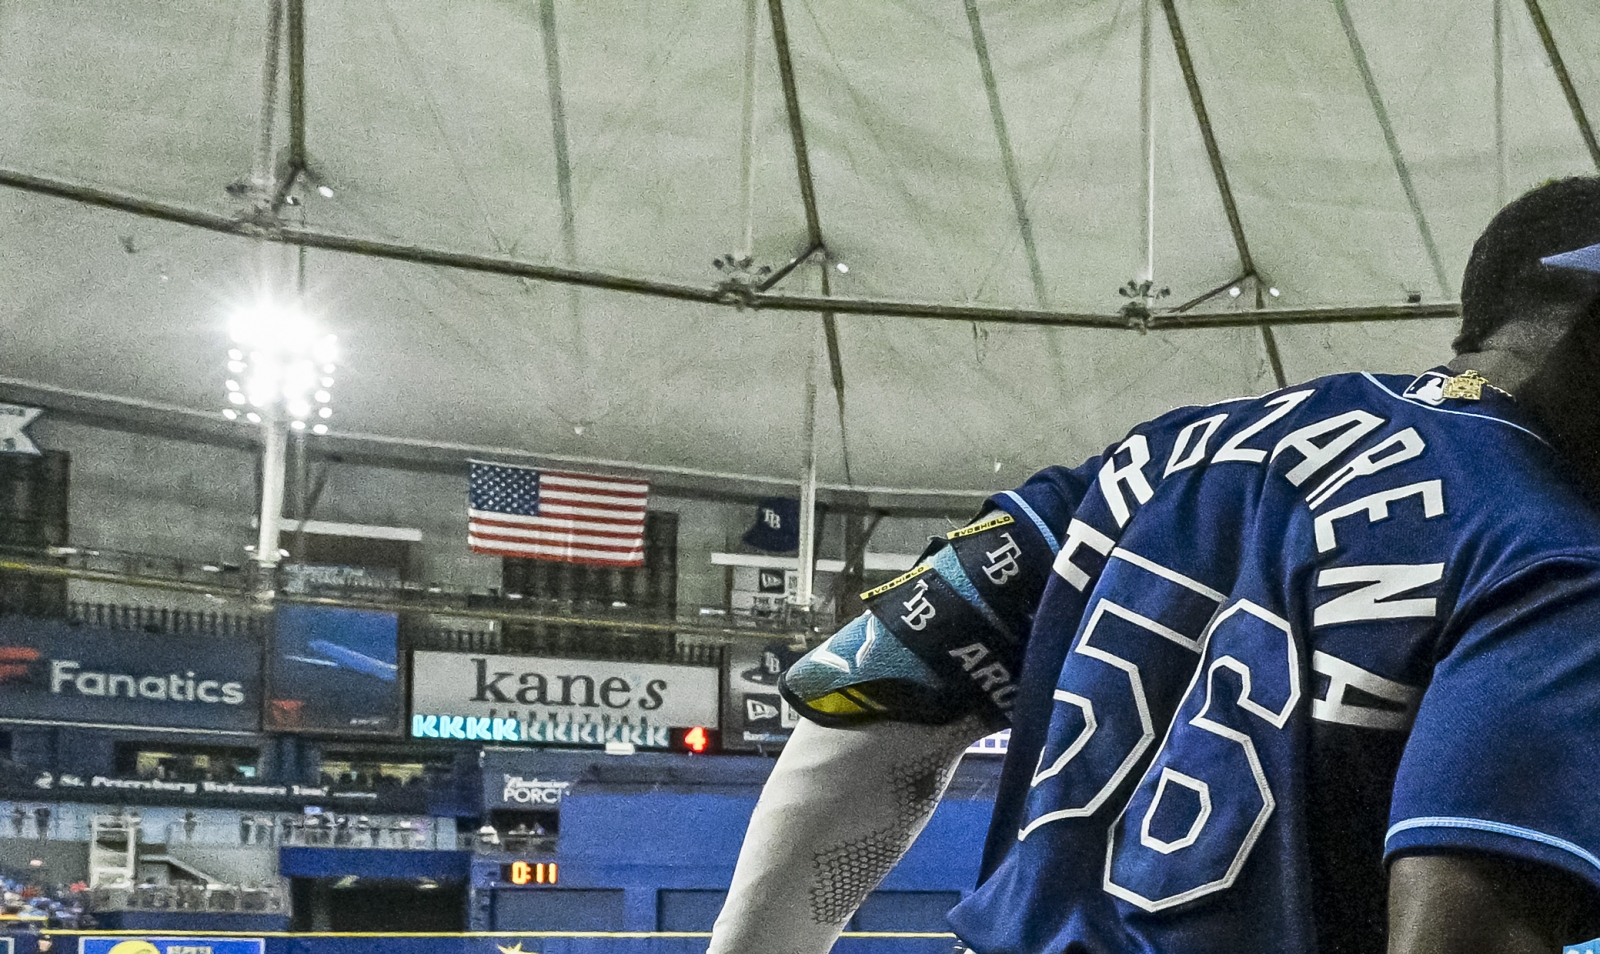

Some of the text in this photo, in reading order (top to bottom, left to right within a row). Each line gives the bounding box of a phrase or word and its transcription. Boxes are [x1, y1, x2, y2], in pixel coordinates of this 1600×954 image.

[51, 659, 245, 705] Fanatics
[684, 726, 708, 752] 4
[1017, 547, 1301, 913] 56
[511, 860, 558, 885] 0:11
